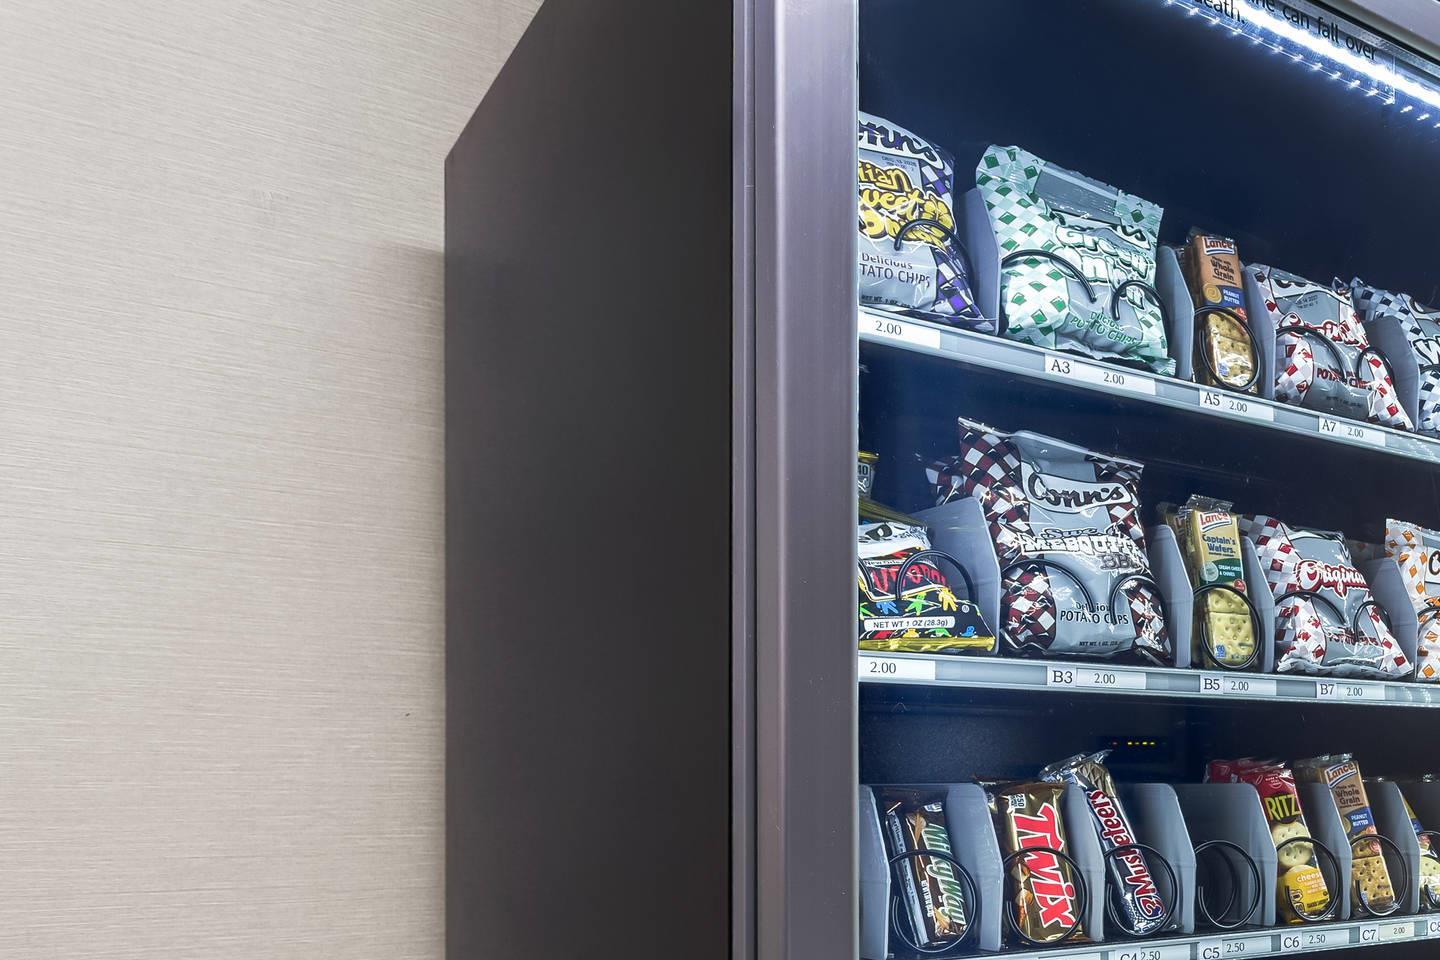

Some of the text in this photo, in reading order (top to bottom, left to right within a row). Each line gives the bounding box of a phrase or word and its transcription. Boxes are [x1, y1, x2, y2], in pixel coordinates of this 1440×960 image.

[1282, 5, 1310, 29] can
[1317, 16, 1340, 44] fall
[1345, 36, 1377, 60] over
[1204, 237, 1233, 250] Lance
[861, 252, 914, 271] Delicious
[1210, 259, 1235, 275] Whole
[898, 269, 931, 289] CHIPS
[1213, 267, 1234, 282] Grain
[875, 320, 902, 337] 2.00
[1051, 358, 1125, 385] A3 2.00
[1204, 392, 1248, 414] A5 2.00
[1322, 419, 1364, 439] A7 2.00
[1027, 471, 1126, 509] Conn's
[1199, 511, 1230, 526] Lance
[1201, 534, 1236, 547] Captain's
[873, 621, 891, 630] NET
[891, 621, 904, 629] WT
[923, 619, 949, 629] (28.3g)
[870, 661, 897, 675] 2.00
[1052, 670, 1116, 685] B3 2.00
[1203, 677, 1250, 692] B5 2.00
[1320, 682, 1363, 698] B7 2.00
[1327, 761, 1356, 781] Lance
[1335, 788, 1361, 799] Whole
[1339, 795, 1361, 806] Grain
[1263, 793, 1301, 822] RITZ
[1351, 813, 1368, 821] PEANUT
[1352, 819, 1369, 828] BUTTER
[1140, 893, 1165, 921] 3
[1283, 933, 1326, 949] C6 2.50
[1362, 925, 1406, 942] C7 2.00
[1202, 942, 1245, 960] C5 2.50
